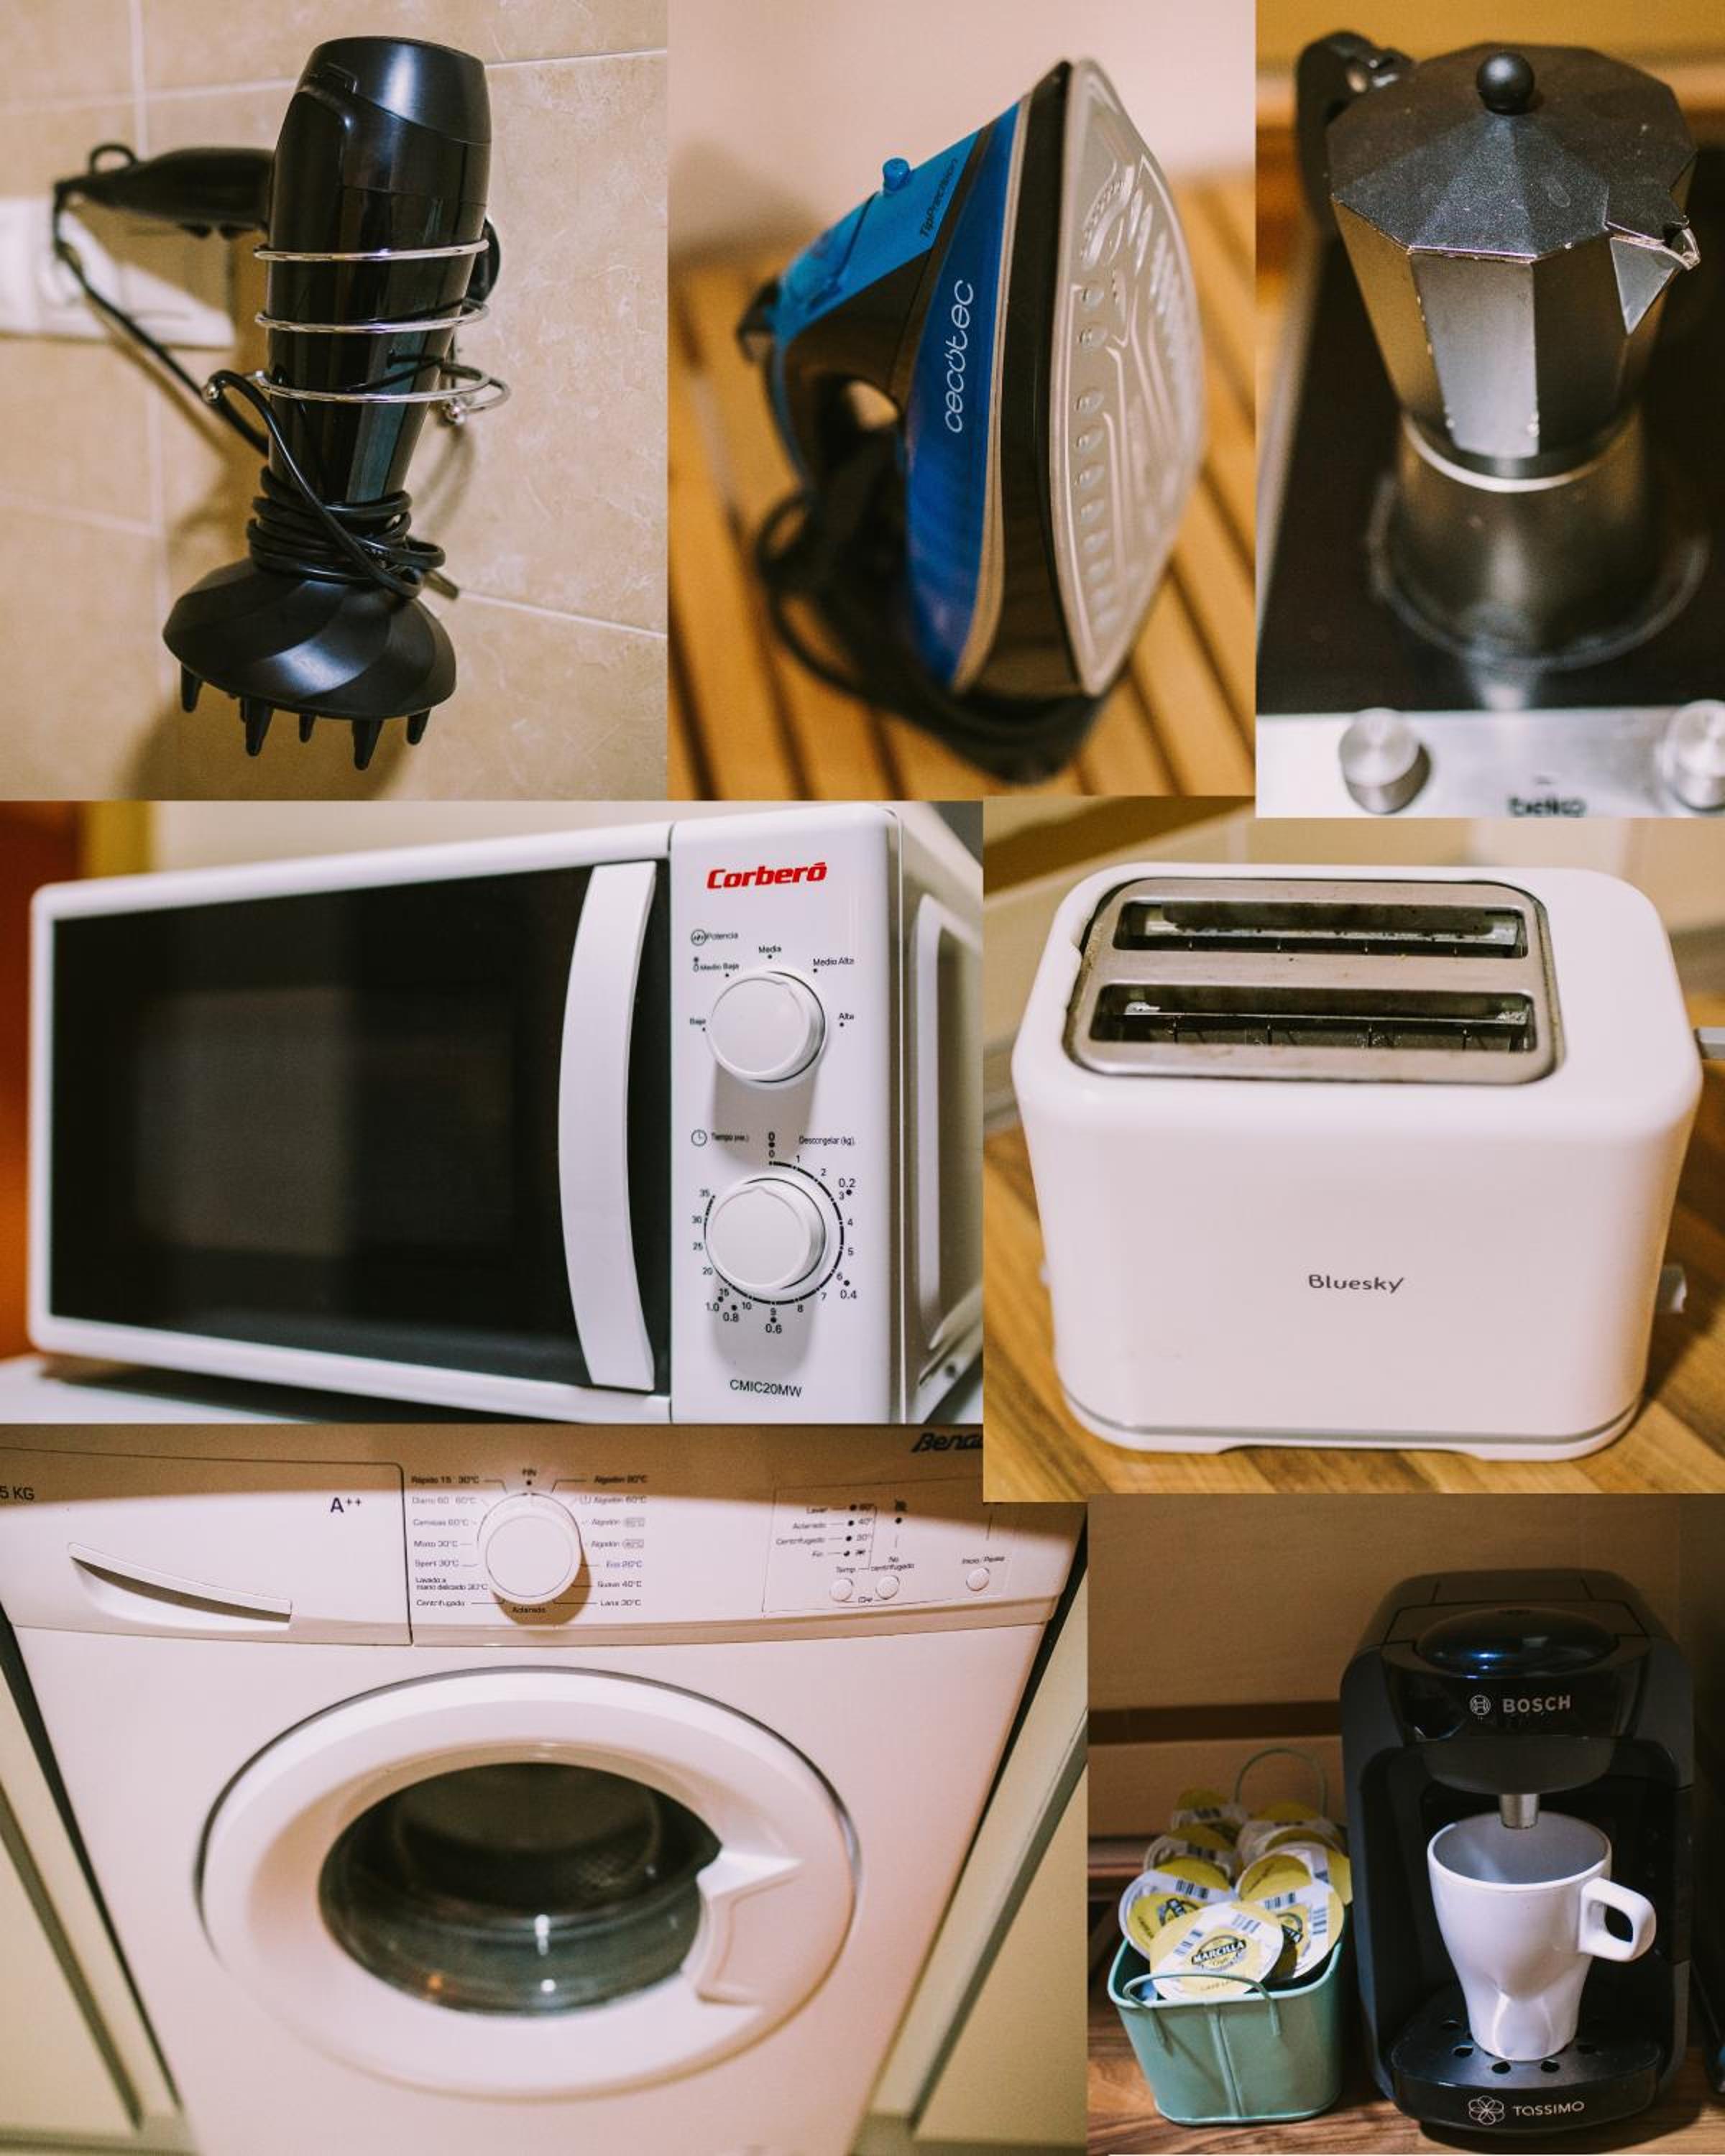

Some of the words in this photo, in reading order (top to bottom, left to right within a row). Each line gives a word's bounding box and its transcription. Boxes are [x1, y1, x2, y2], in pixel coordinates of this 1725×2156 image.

[820, 1168, 827, 1176] 2
[838, 1178, 856, 1189] 0.2
[699, 1189, 710, 1198] 35
[838, 1192, 845, 1200] 3
[691, 1215, 702, 1225] 30
[847, 1218, 854, 1227] 4
[692, 1242, 704, 1251] 25
[847, 1247, 855, 1256] 5
[702, 1266, 714, 1276] 20
[836, 1272, 843, 1281] 6
[1308, 1273, 1404, 1294] Bluesky
[821, 1291, 827, 1301] 7
[840, 1289, 857, 1300] 0.4
[706, 1302, 719, 1312] 1.0
[742, 1302, 752, 1311] 10
[770, 1307, 777, 1316] 9
[797, 1304, 804, 1313] 8
[722, 1312, 740, 1323] 0.8
[765, 1323, 783, 1335] 0.6
[730, 1378, 803, 1398] CMIC20MW
[12, 1485, 35, 1501] KG
[330, 1497, 362, 1514] A++
[1502, 1694, 1571, 1713] BOSCH
